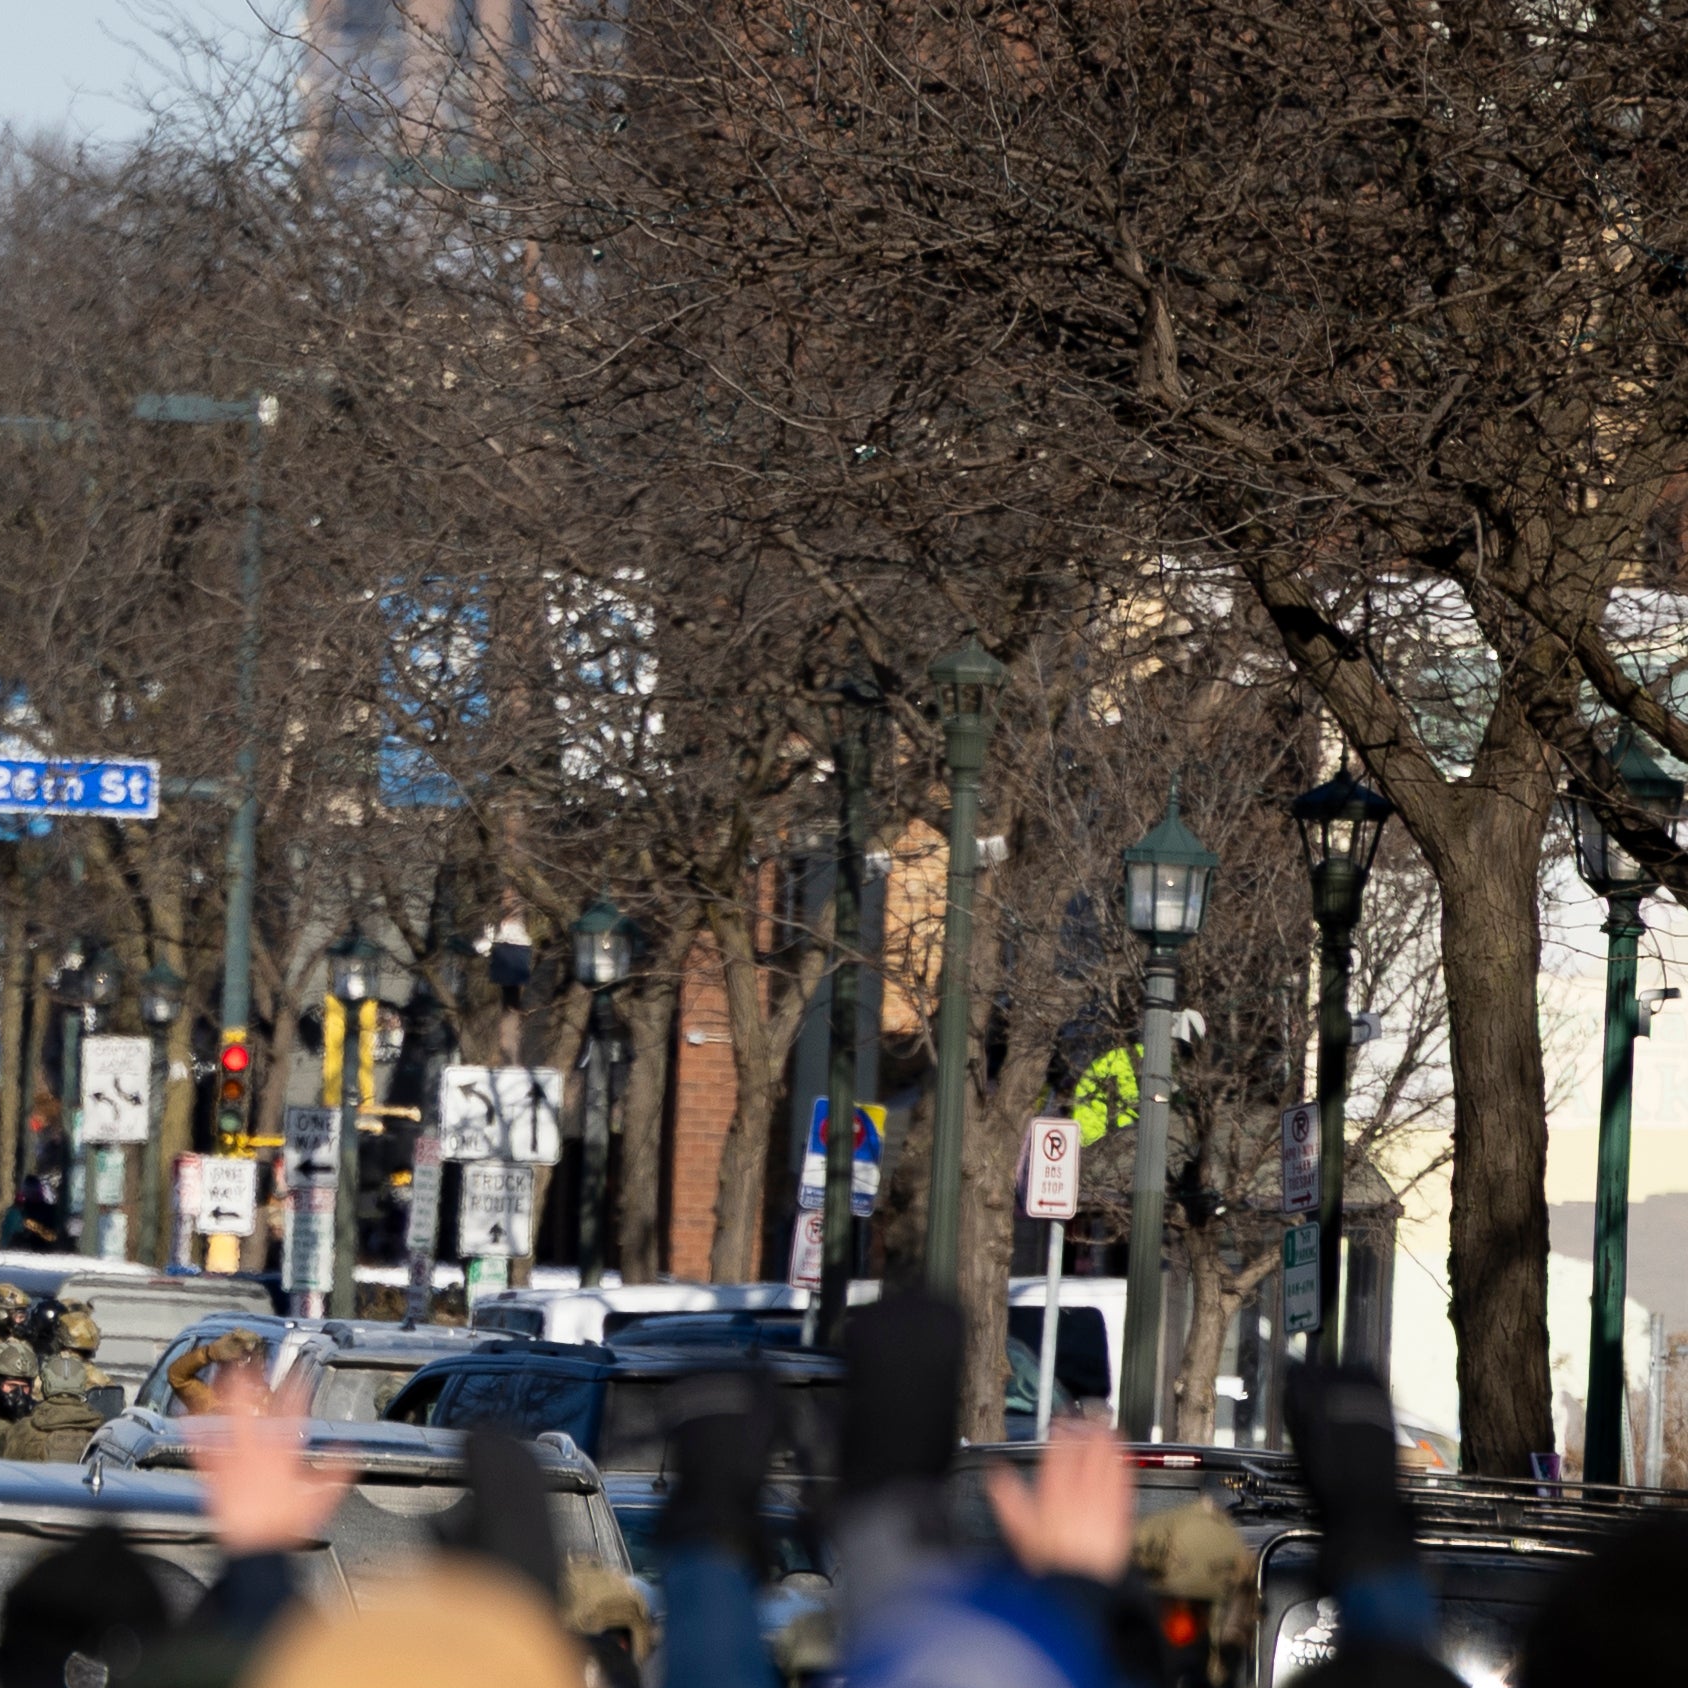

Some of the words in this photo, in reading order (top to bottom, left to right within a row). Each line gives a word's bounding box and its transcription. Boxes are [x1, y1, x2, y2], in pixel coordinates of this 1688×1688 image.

[98, 770, 146, 805] St
[296, 1114, 333, 1132] ONE
[295, 1135, 336, 1152] WAY
[1045, 1166, 1063, 1179] BUS
[472, 1172, 526, 1192] TRUCK
[1041, 1183, 1065, 1194] STOP
[471, 1195, 524, 1214] ROUTE
